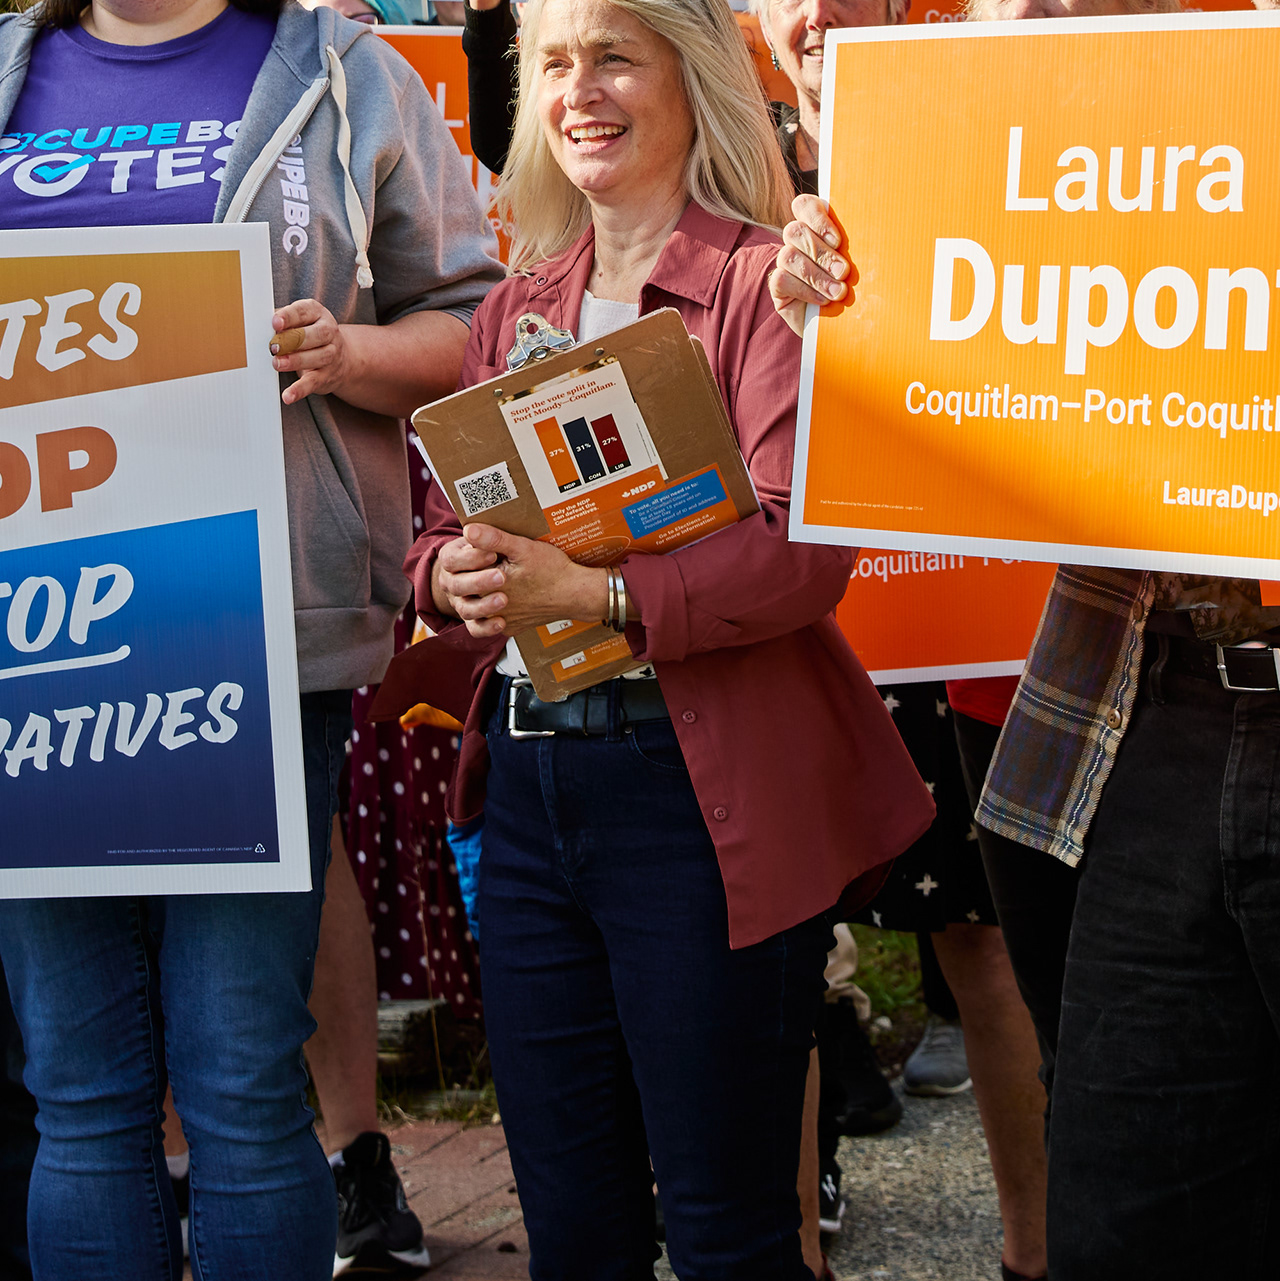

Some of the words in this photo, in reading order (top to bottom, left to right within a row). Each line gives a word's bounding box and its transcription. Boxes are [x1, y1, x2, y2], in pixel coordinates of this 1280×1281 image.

[1004, 126, 1245, 214] Laura
[510, 406, 530, 417] Stop
[531, 400, 545, 409] the
[547, 393, 565, 403] vote
[566, 384, 586, 395] split
[513, 413, 532, 424] Port
[602, 437, 617, 446] 27%
[549, 448, 564, 457] 37%
[576, 443, 591, 452] 31%
[588, 472, 601, 480] CON
[630, 481, 656, 496] NDP
[659, 494, 670, 502] you
[670, 487, 684, 497] need
[551, 509, 565, 517] Only
[565, 506, 585, 517] defeat
